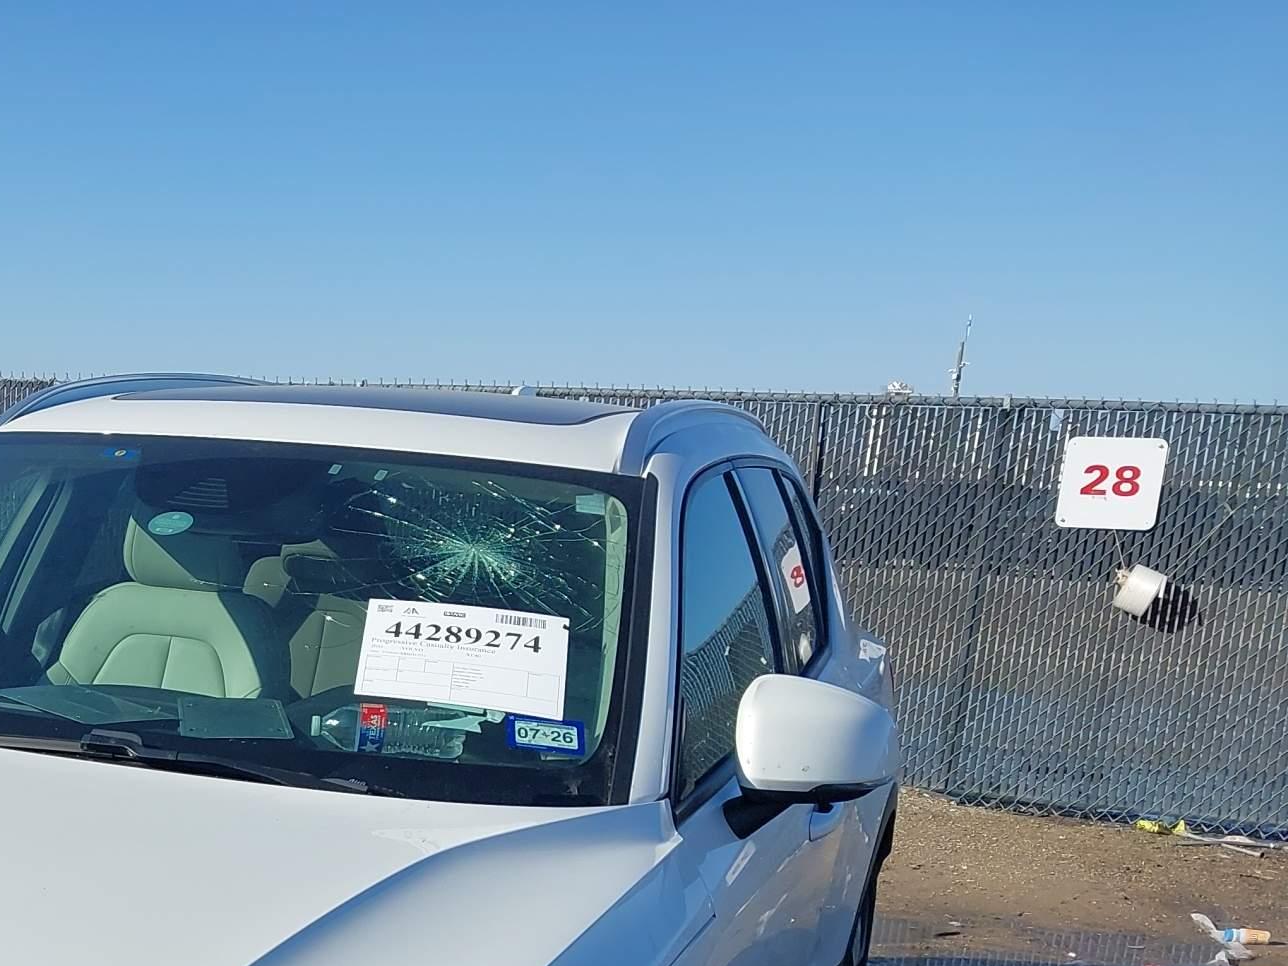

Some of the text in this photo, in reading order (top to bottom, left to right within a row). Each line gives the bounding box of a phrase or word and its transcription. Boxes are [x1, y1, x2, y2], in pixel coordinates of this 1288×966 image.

[1080, 464, 1141, 497] 28
[372, 637, 418, 646] Progressive
[457, 645, 496, 655] Insurance
[385, 621, 541, 653] 44289274
[367, 714, 378, 740] TEXAS
